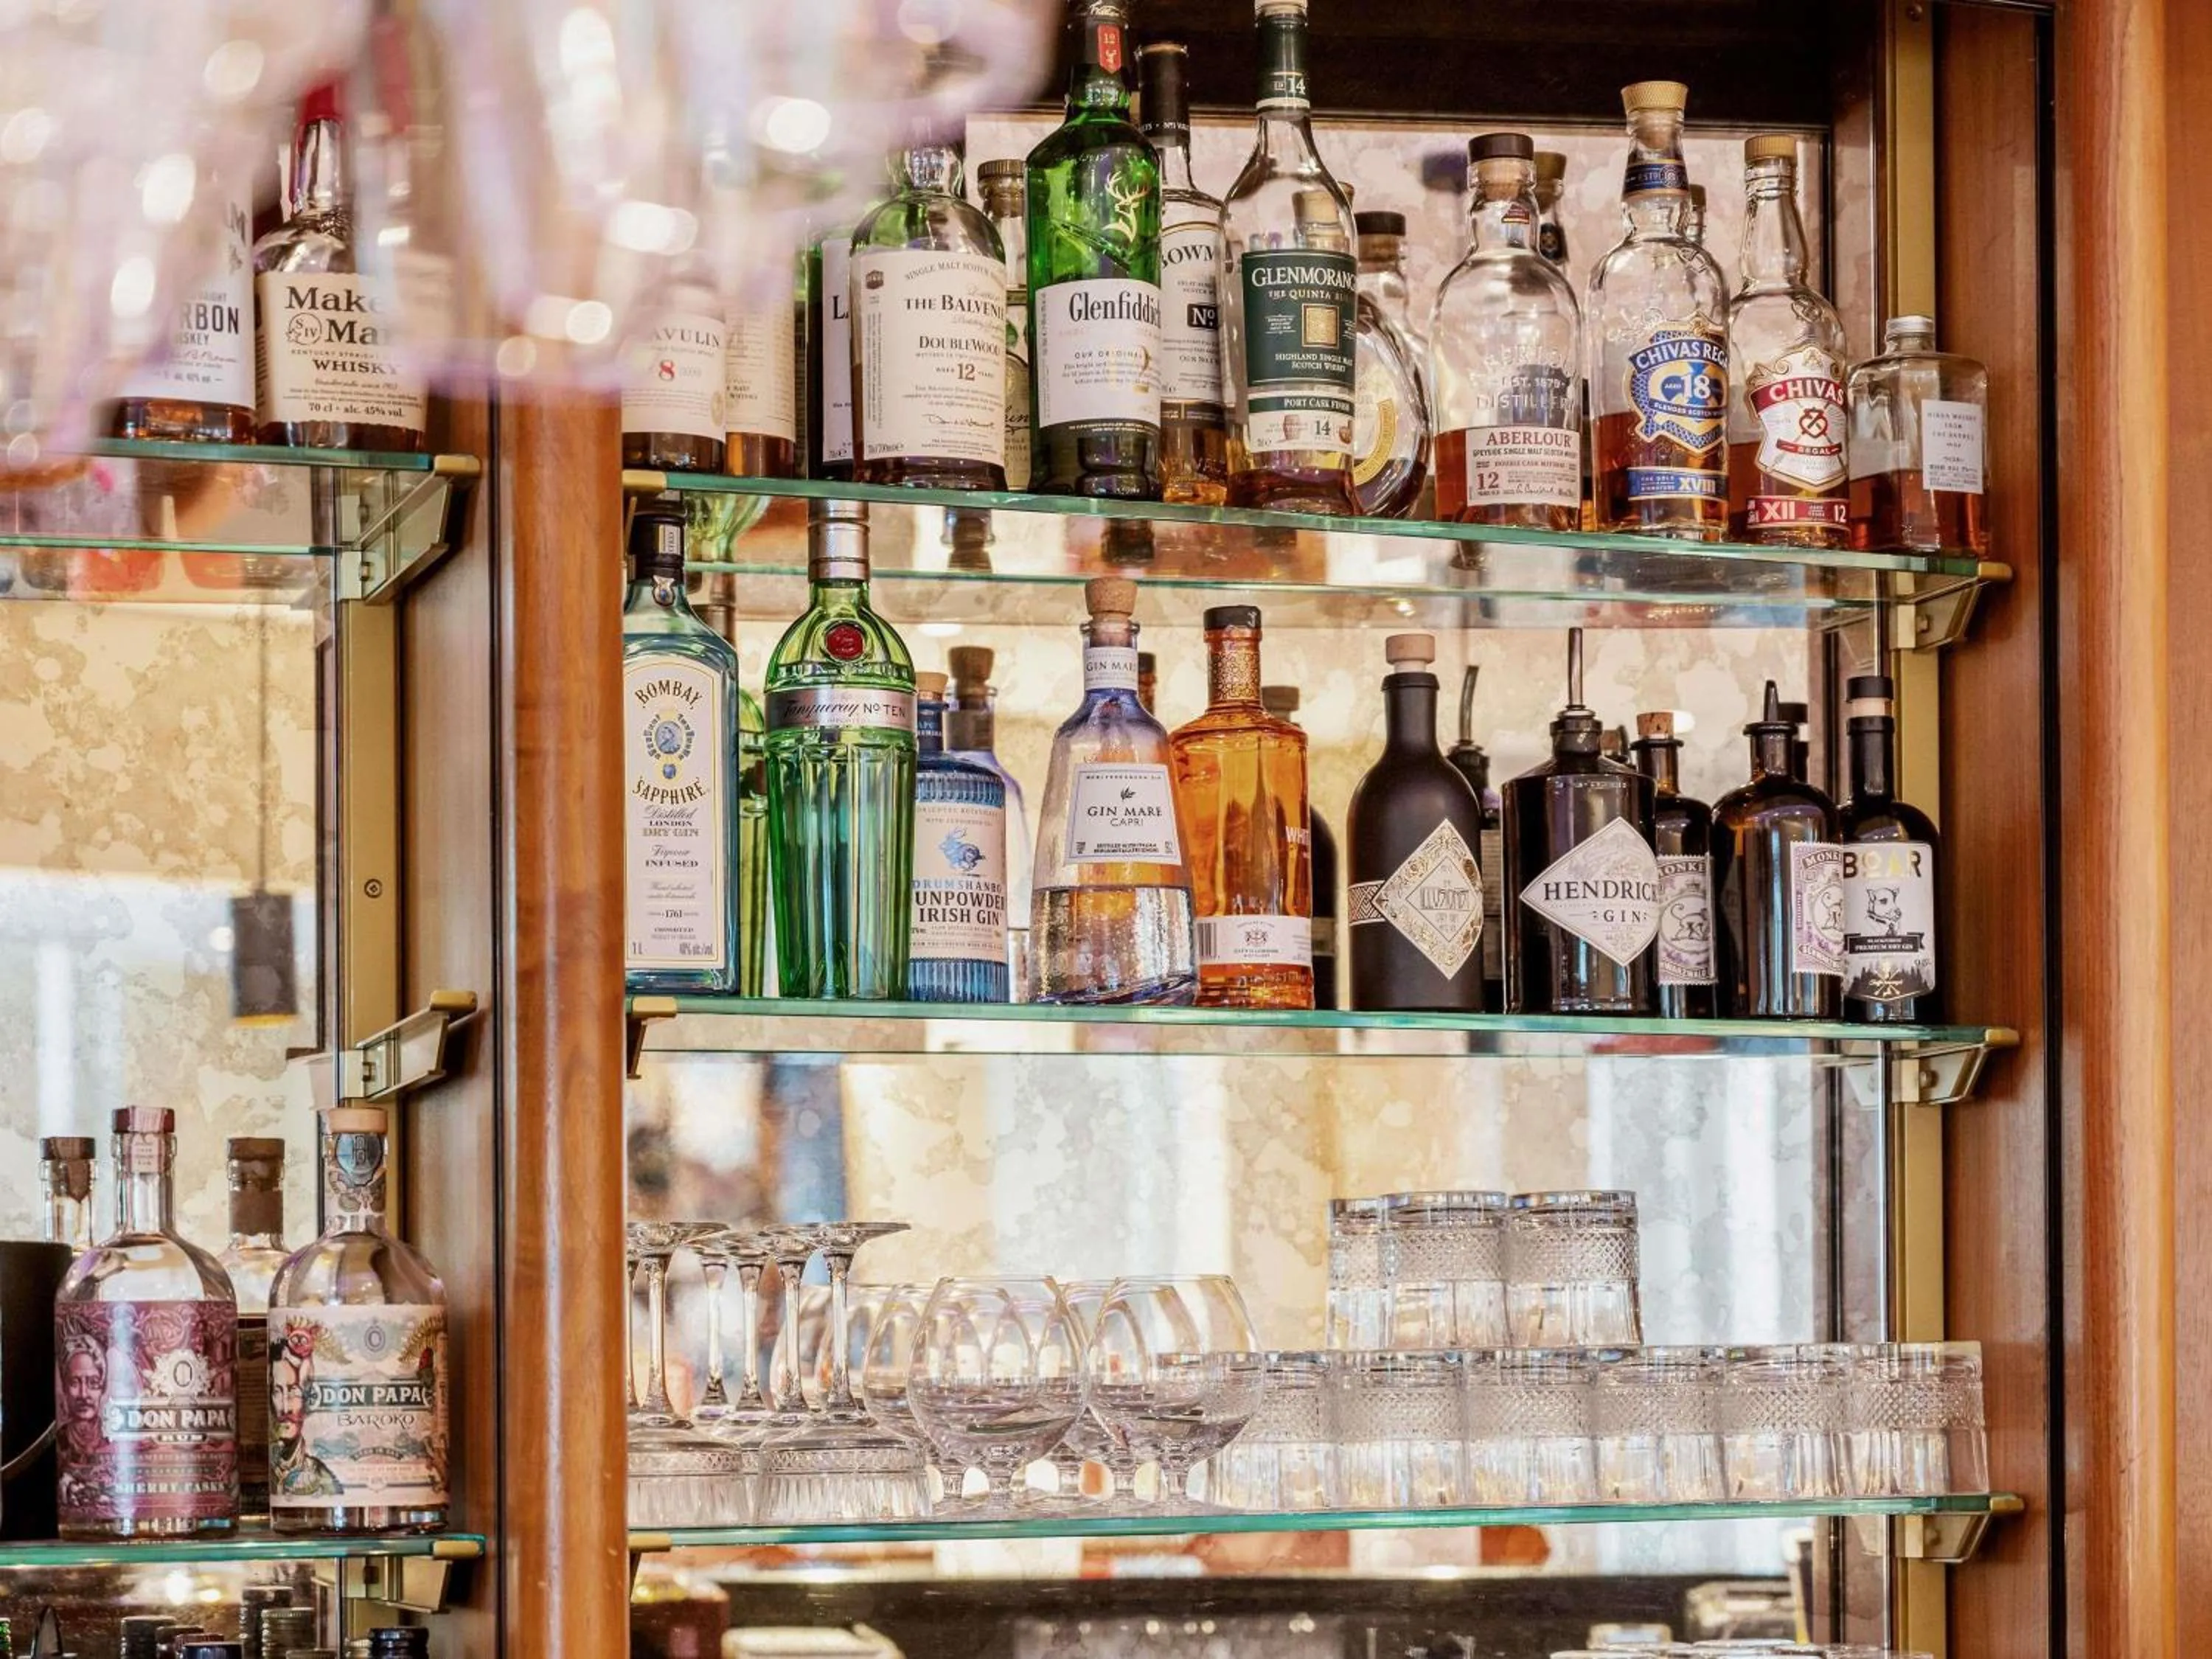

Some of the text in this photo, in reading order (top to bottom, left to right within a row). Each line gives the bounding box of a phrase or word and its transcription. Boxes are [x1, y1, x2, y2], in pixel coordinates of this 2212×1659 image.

[1287, 77, 1306, 95] 14
[937, 261, 960, 270] MALT
[905, 298, 937, 310] THE
[1275, 352, 1318, 361] HIGHLAND
[1636, 341, 1701, 369] CHIVAS
[658, 359, 675, 382] 8
[957, 363, 976, 381] 12
[1291, 361, 1322, 370] SCOTCH
[1681, 374, 1711, 400] 18
[1769, 379, 1844, 406] CHIVAS
[1284, 398, 1306, 408] PORT
[1309, 398, 1329, 408] CASK
[1315, 420, 1331, 436] 14
[1486, 431, 1572, 448] ABERLOUR
[1503, 448, 1526, 456] SINGLE
[1527, 448, 1543, 456] MALT
[1797, 446, 1832, 456] REGAL
[1477, 471, 1500, 490] 12
[1761, 501, 1796, 521] XII
[1834, 504, 1847, 523] 12
[1086, 661, 1107, 672] GIN
[635, 679, 703, 709] BOMBAY
[784, 700, 860, 718] Tanqueray
[883, 703, 906, 717] TEN
[632, 778, 706, 805] SAPPHIRE
[1087, 806, 1163, 817] GIN MARE
[1110, 817, 1144, 827] CAPRI
[642, 828, 670, 837] DRY
[644, 860, 699, 868] INFUSED
[1843, 850, 1922, 879] BOAR
[919, 908, 1000, 926] IRISH GIN
[1603, 909, 1641, 922] GIN
[323, 1386, 422, 1403] DON PAPA
[128, 1409, 227, 1429] DON PAPA
[337, 1413, 416, 1429] BAROKO
[158, 1433, 204, 1442] RUM
[114, 1481, 179, 1494] SHERRY
